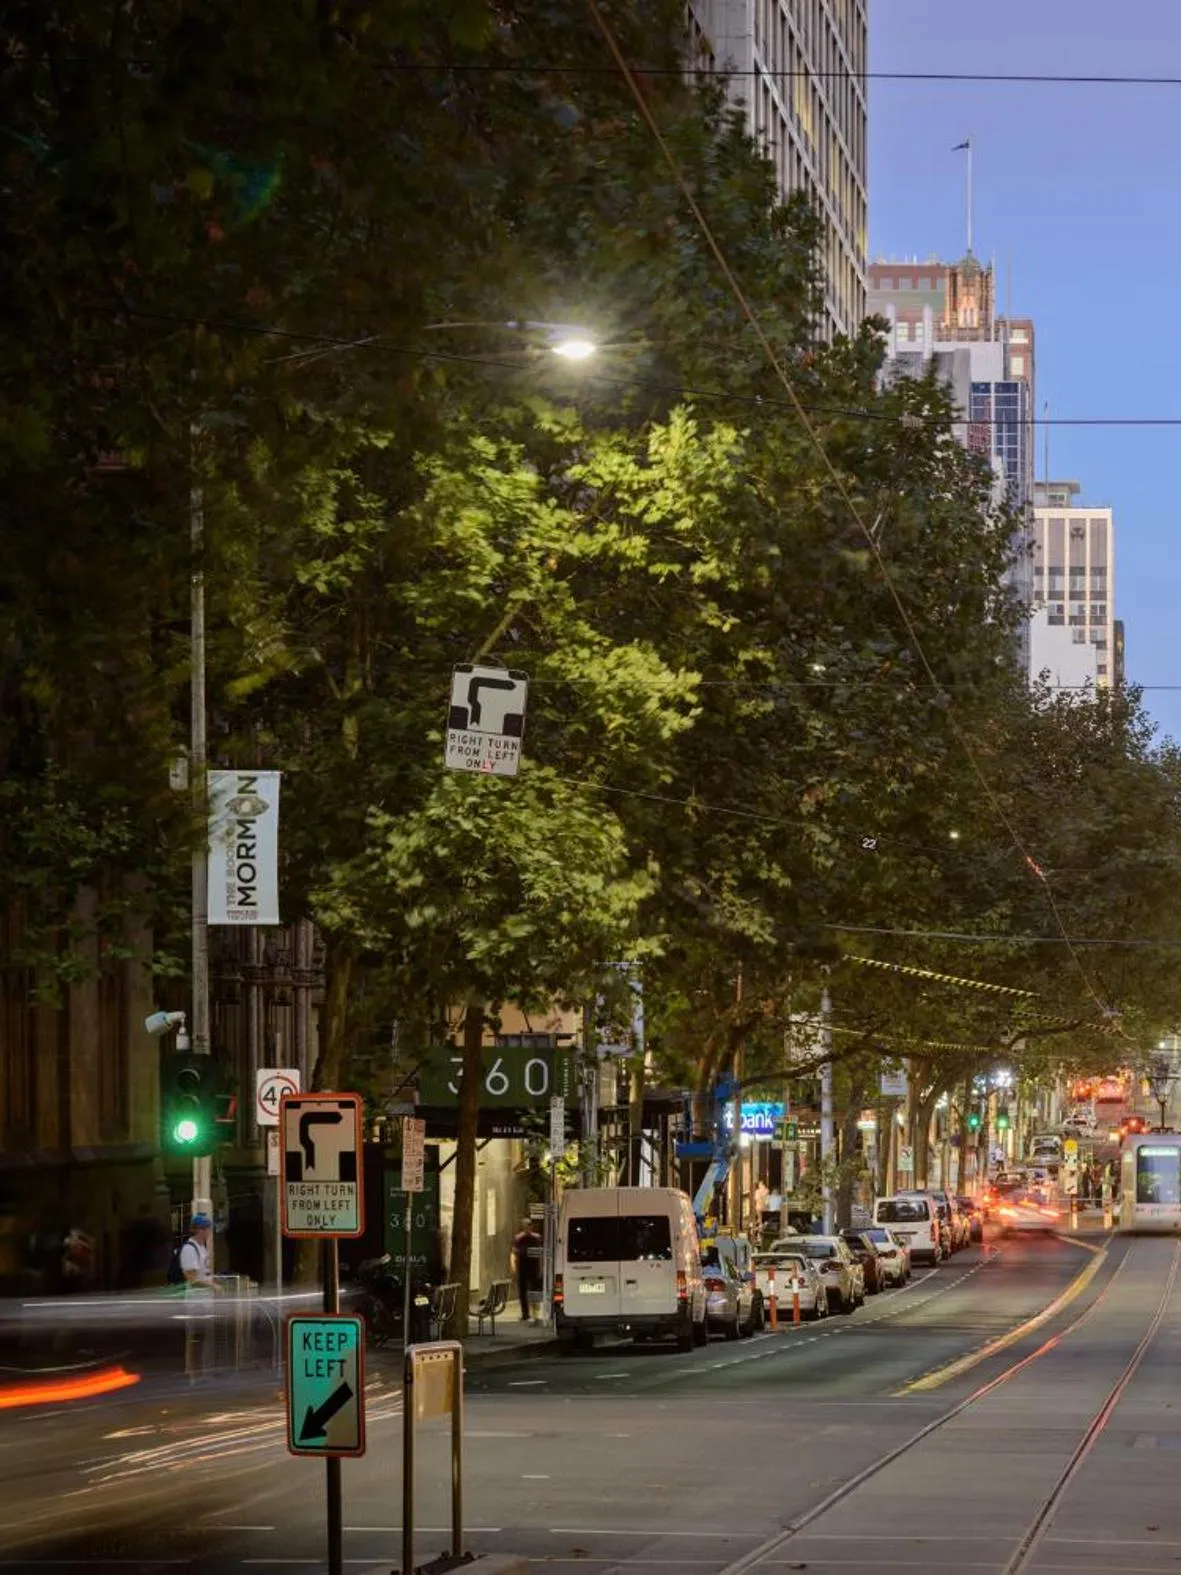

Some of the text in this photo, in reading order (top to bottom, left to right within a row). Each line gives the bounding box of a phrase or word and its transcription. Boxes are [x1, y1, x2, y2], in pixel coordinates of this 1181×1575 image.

[450, 733, 517, 751] RIGHT TURN
[450, 745, 514, 761] FROM LEFT
[466, 758, 496, 769] ONLY
[289, 1184, 353, 1196] RIGHT TURN
[292, 1200, 351, 1211] FROM LEFT
[307, 1214, 337, 1226] ONLY
[303, 1332, 348, 1352] KEEP
[305, 1358, 347, 1378] LEFT
